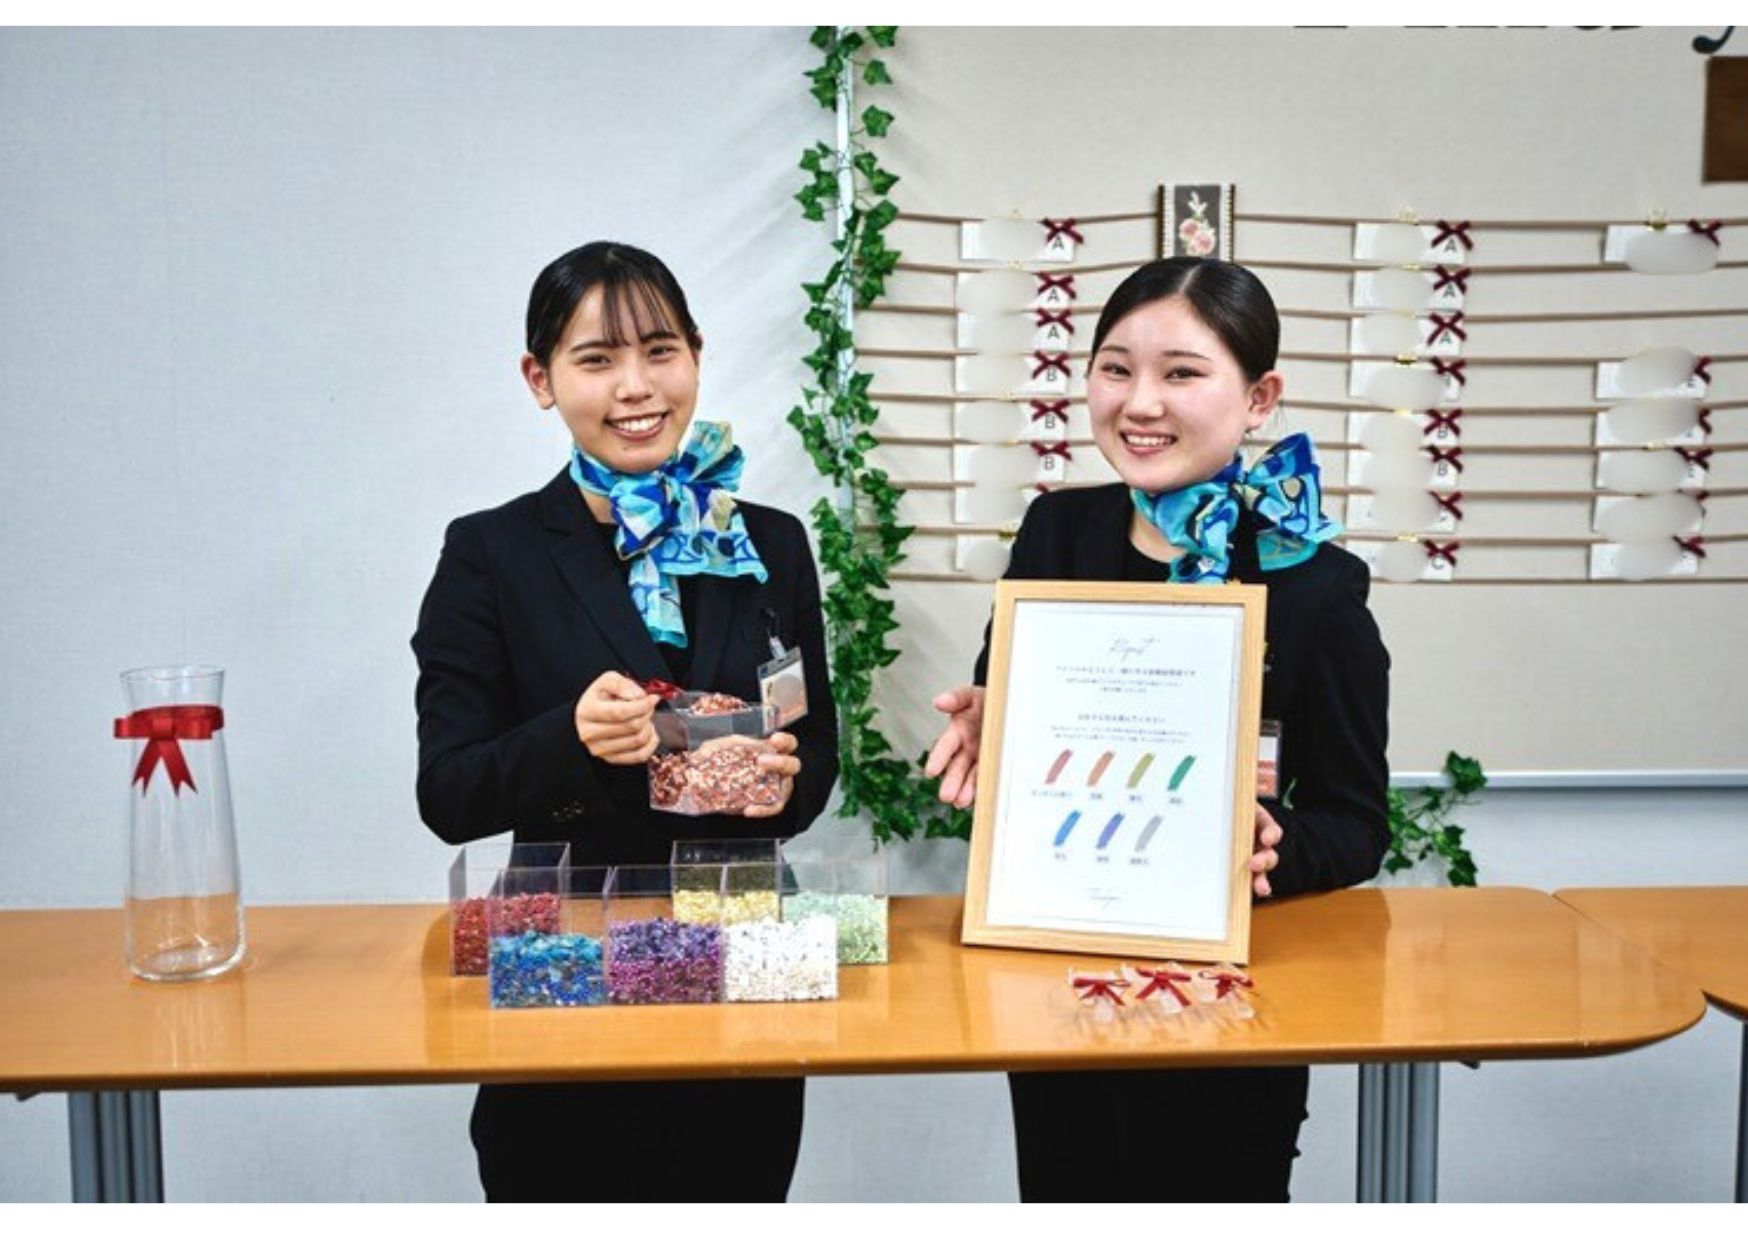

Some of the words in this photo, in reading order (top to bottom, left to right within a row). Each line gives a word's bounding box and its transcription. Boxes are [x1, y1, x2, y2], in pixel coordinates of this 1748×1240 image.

[1052, 235, 1065, 250] A
[1047, 288, 1060, 302] A
[1047, 326, 1060, 340] A
[1045, 415, 1055, 429] B
[1045, 456, 1055, 470] B
